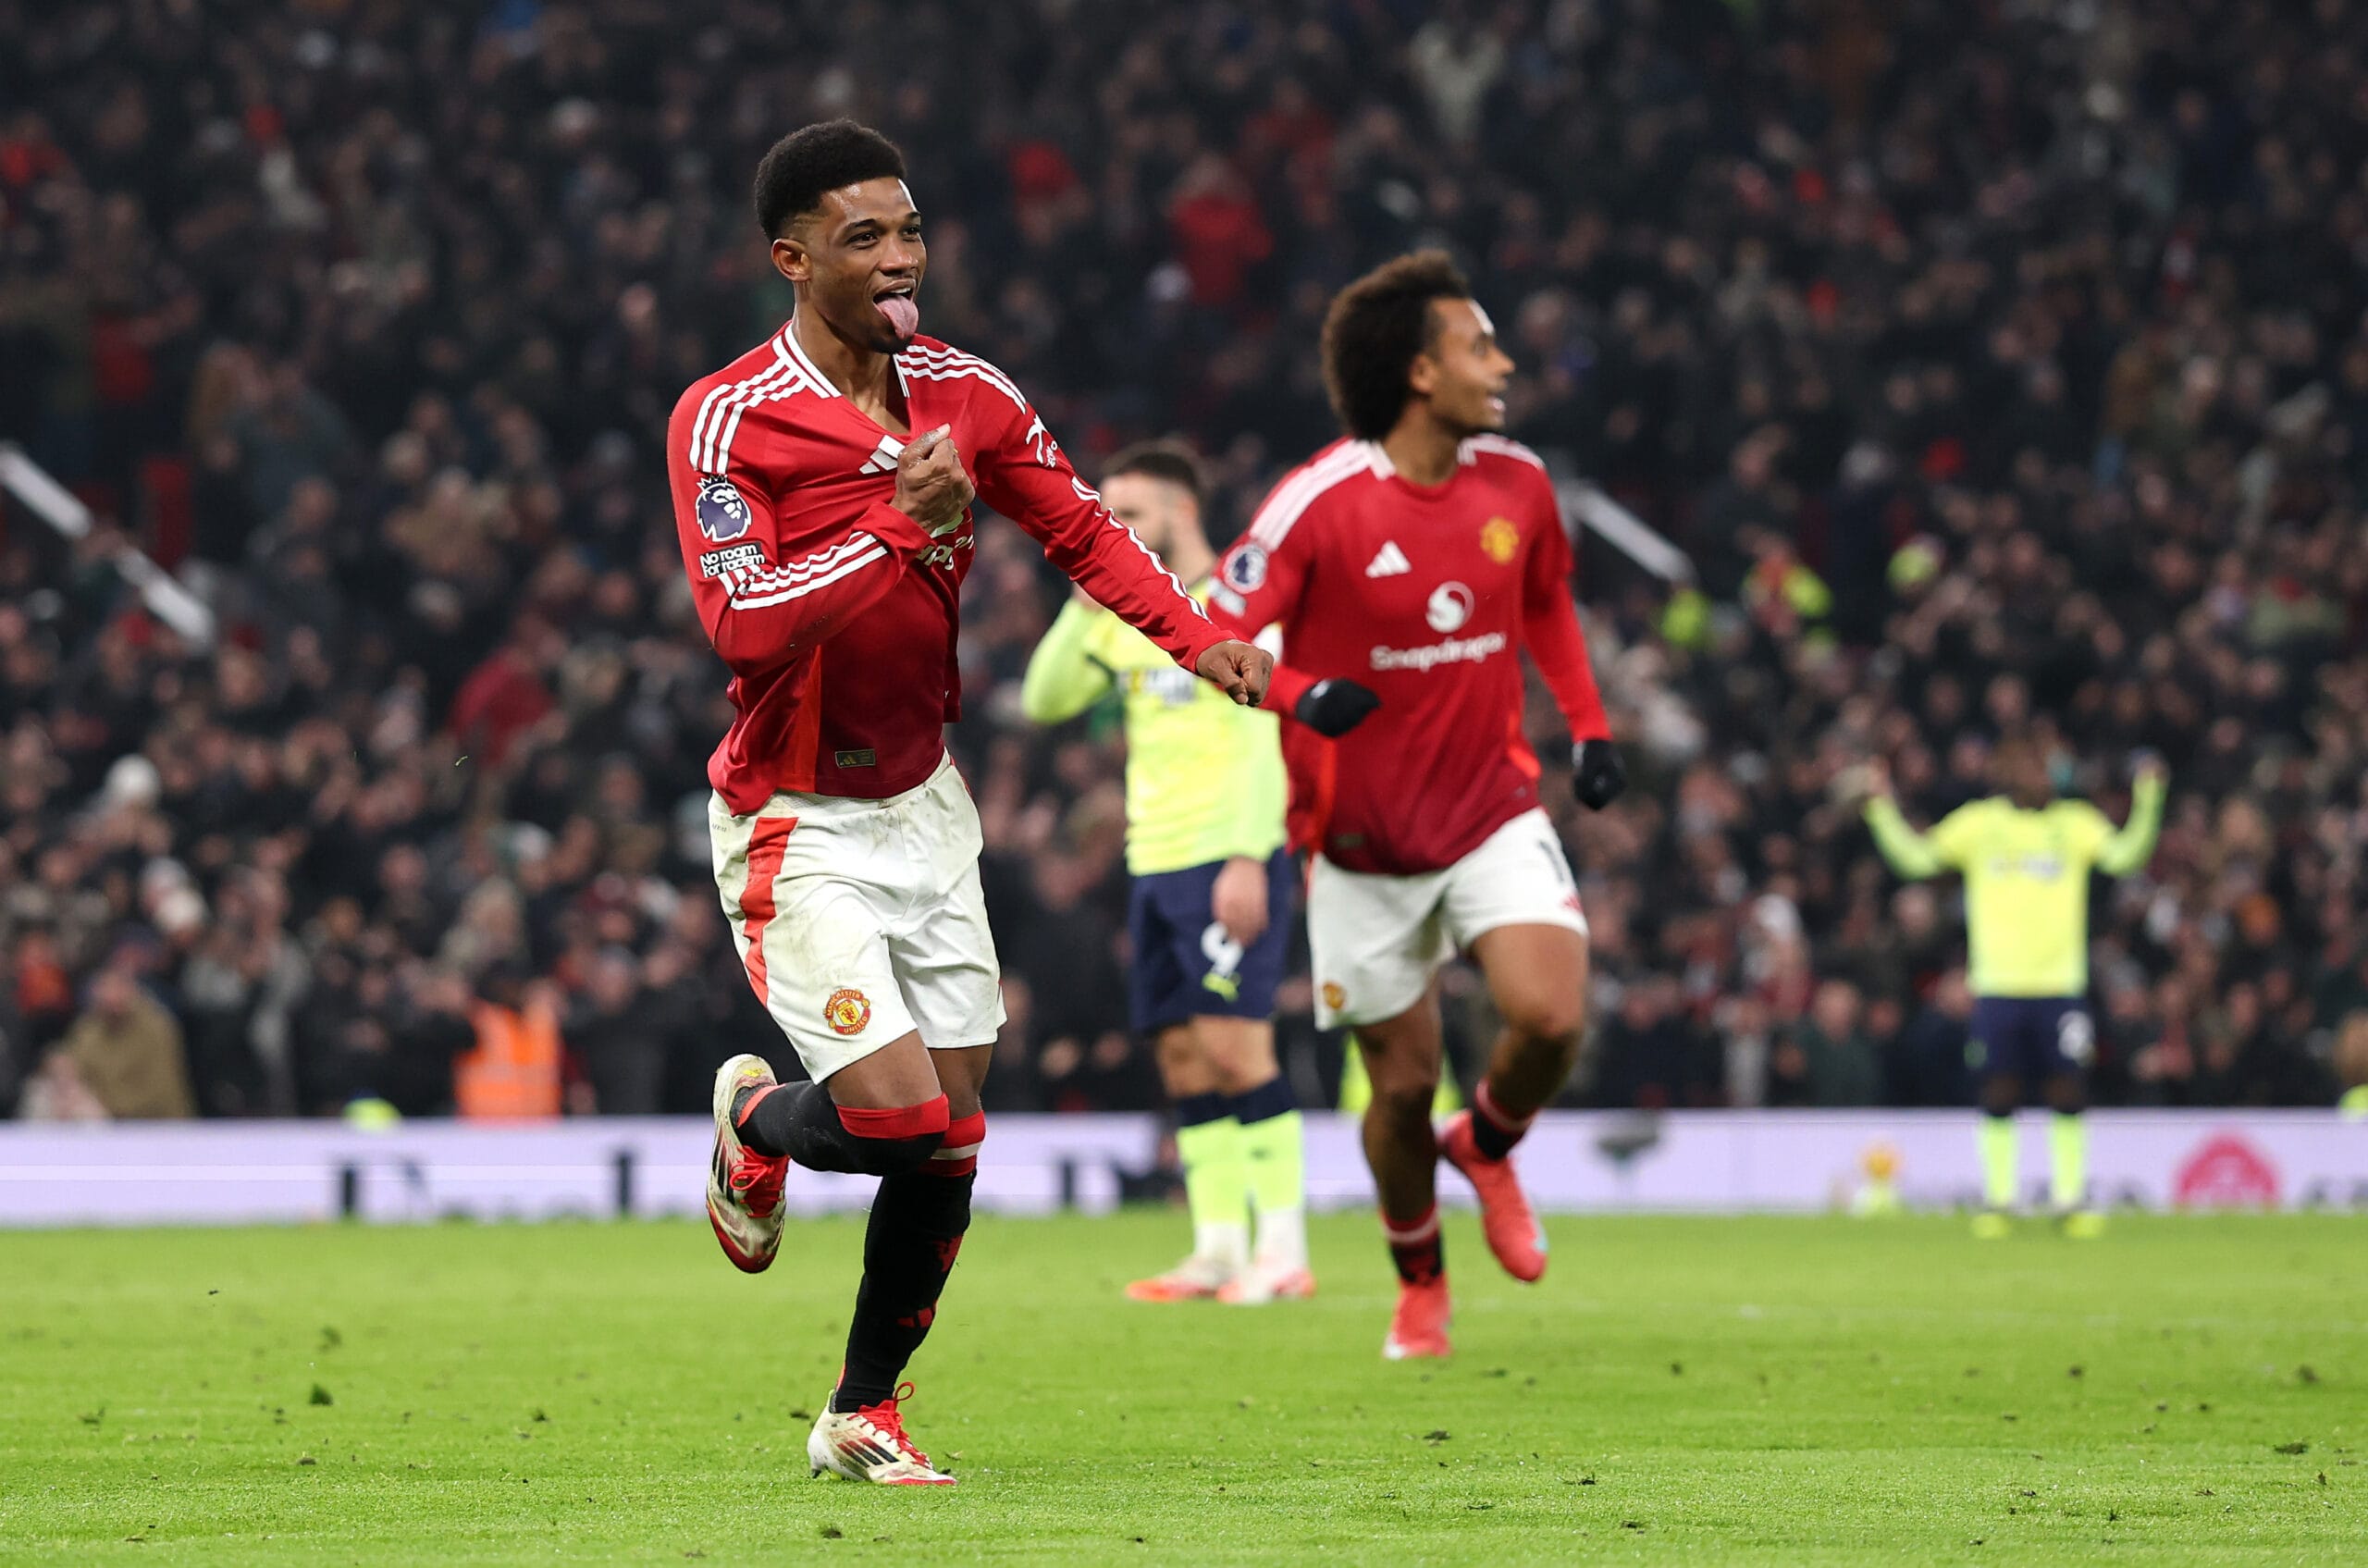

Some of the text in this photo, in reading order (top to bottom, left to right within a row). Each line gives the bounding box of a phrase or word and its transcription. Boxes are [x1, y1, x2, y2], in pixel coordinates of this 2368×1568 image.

[699, 545, 758, 566] No room
[1201, 920, 1244, 979] 9
[826, 990, 861, 1017] MANCHESTER
[843, 1016, 868, 1033] UNITED
